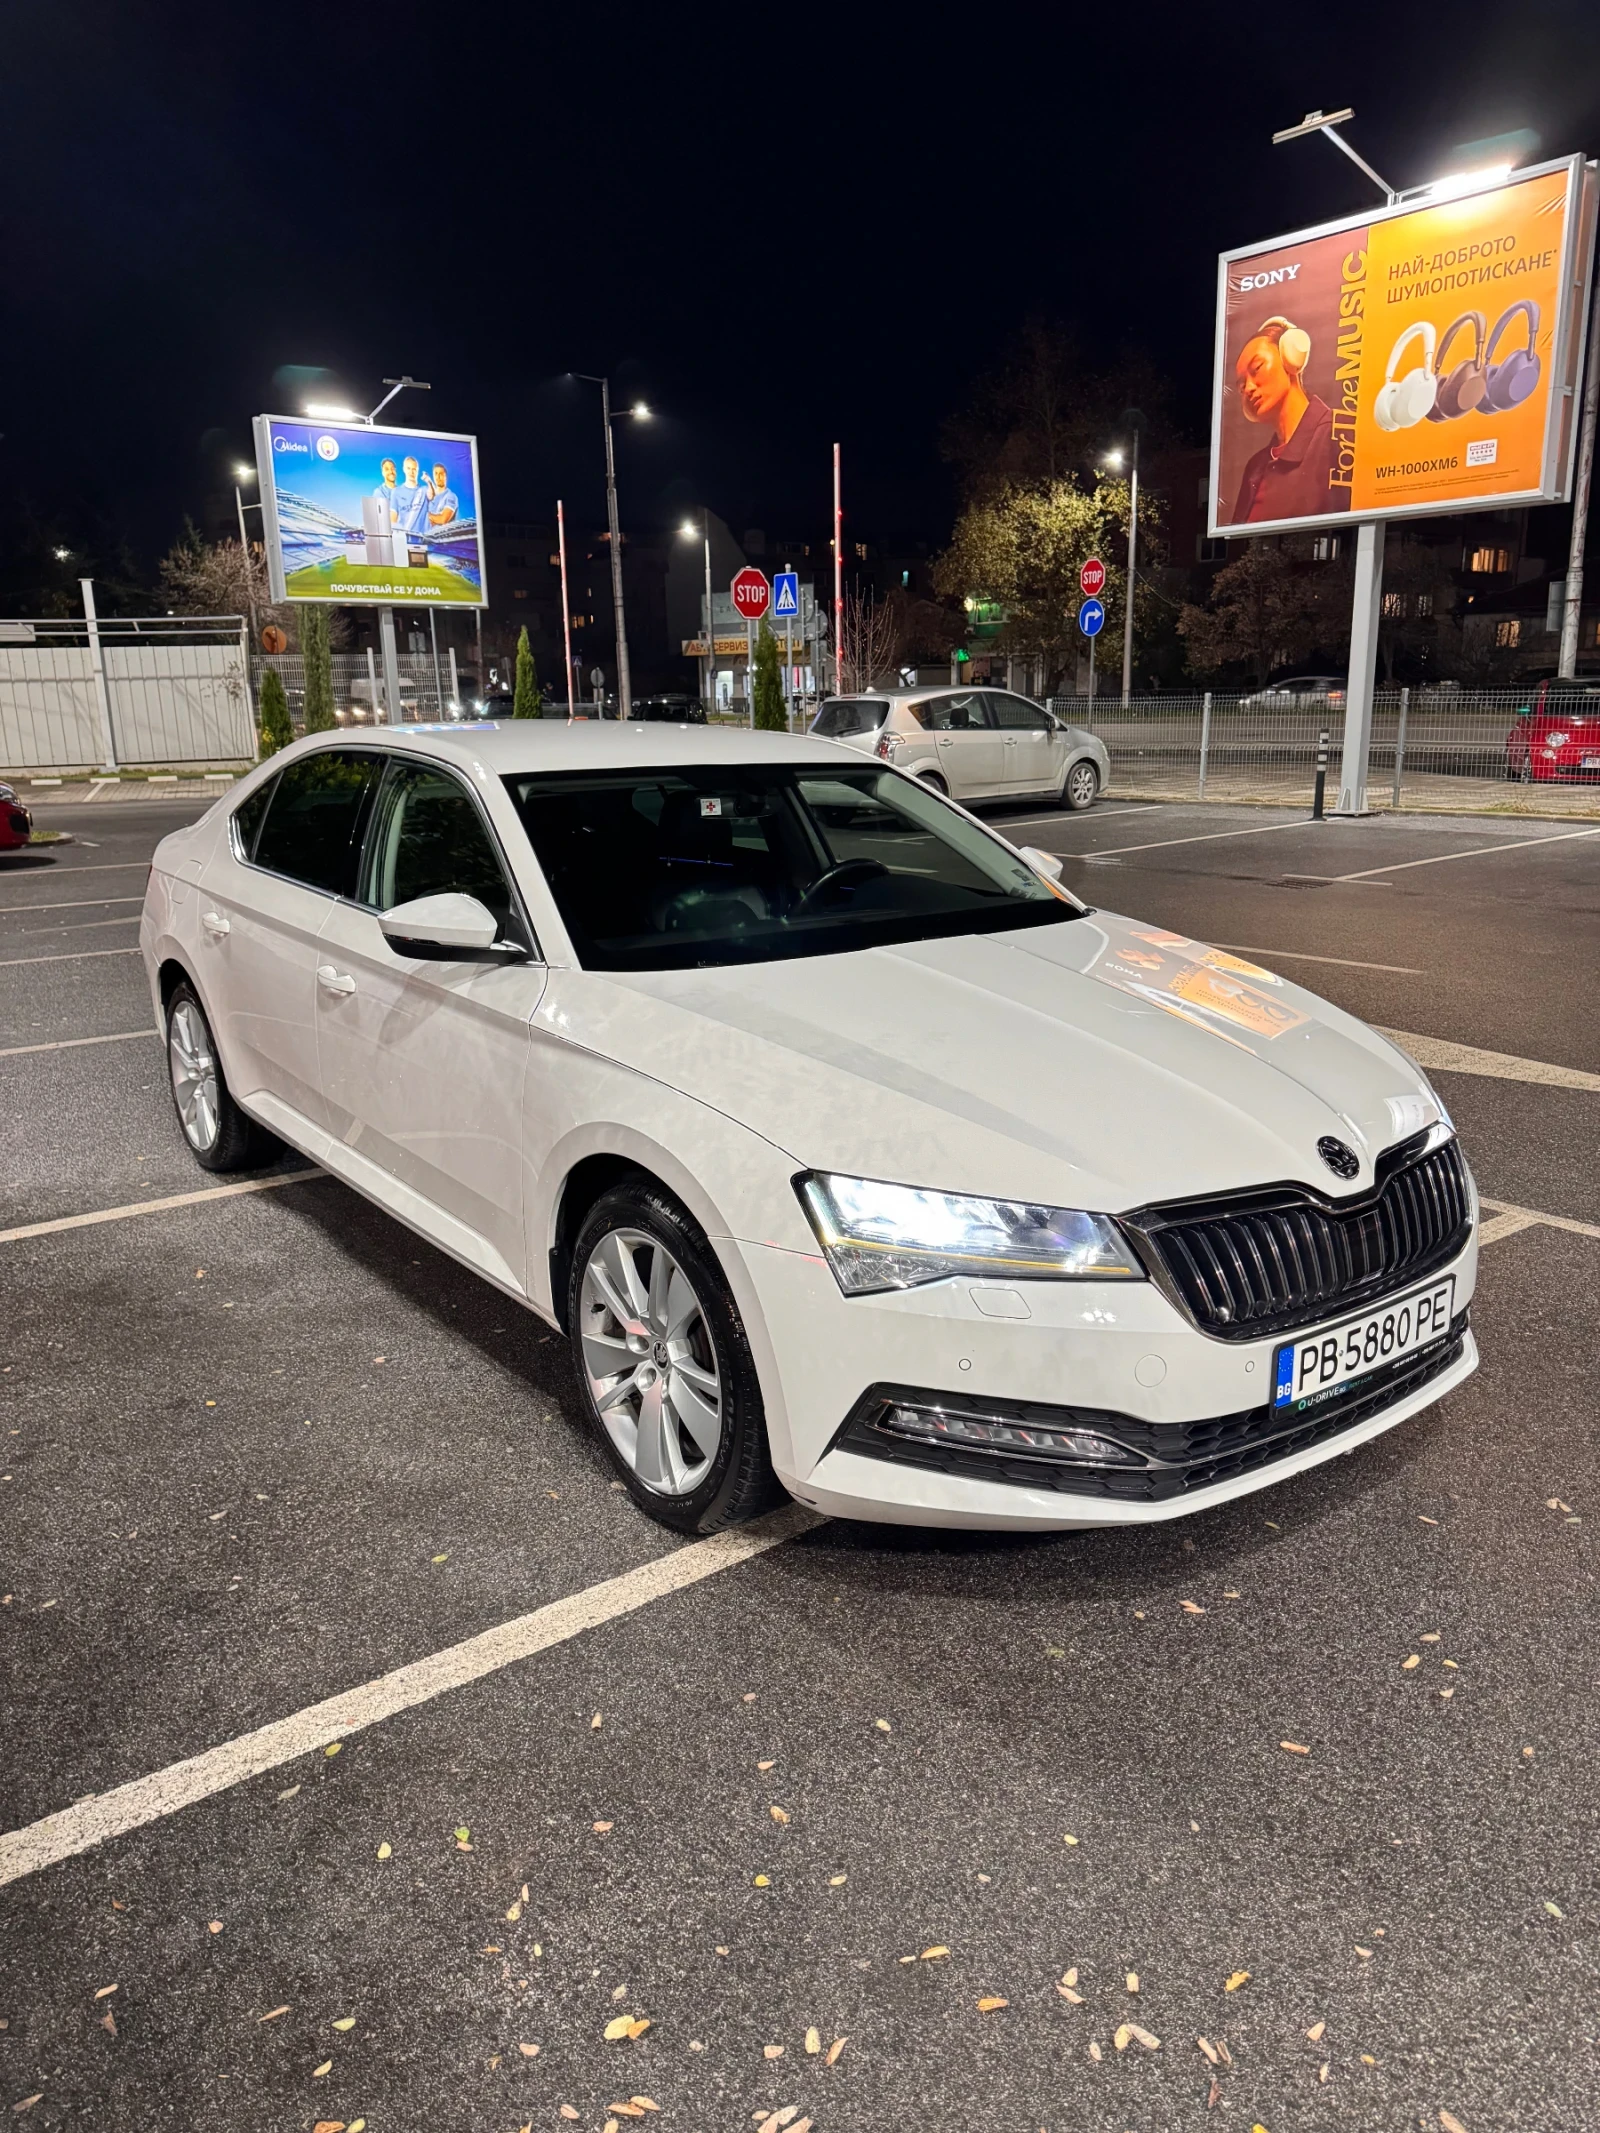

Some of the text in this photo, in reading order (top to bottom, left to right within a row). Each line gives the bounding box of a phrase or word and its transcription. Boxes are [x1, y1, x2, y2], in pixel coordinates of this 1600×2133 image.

[1388, 235, 1516, 281] НАЙ-ДОБРОТО
[1240, 263, 1301, 292] SONY
[275, 438, 308, 452] Midea
[1375, 456, 1458, 479] WH-1000XM6
[1083, 569, 1103, 585] STOP
[330, 583, 441, 596] ПОЧУВСТВАЙ СЕ У ДОМА
[737, 584, 766, 603] STOP
[1298, 1288, 1448, 1393] PB 5880 PE
[1276, 1382, 1291, 1399] BG
